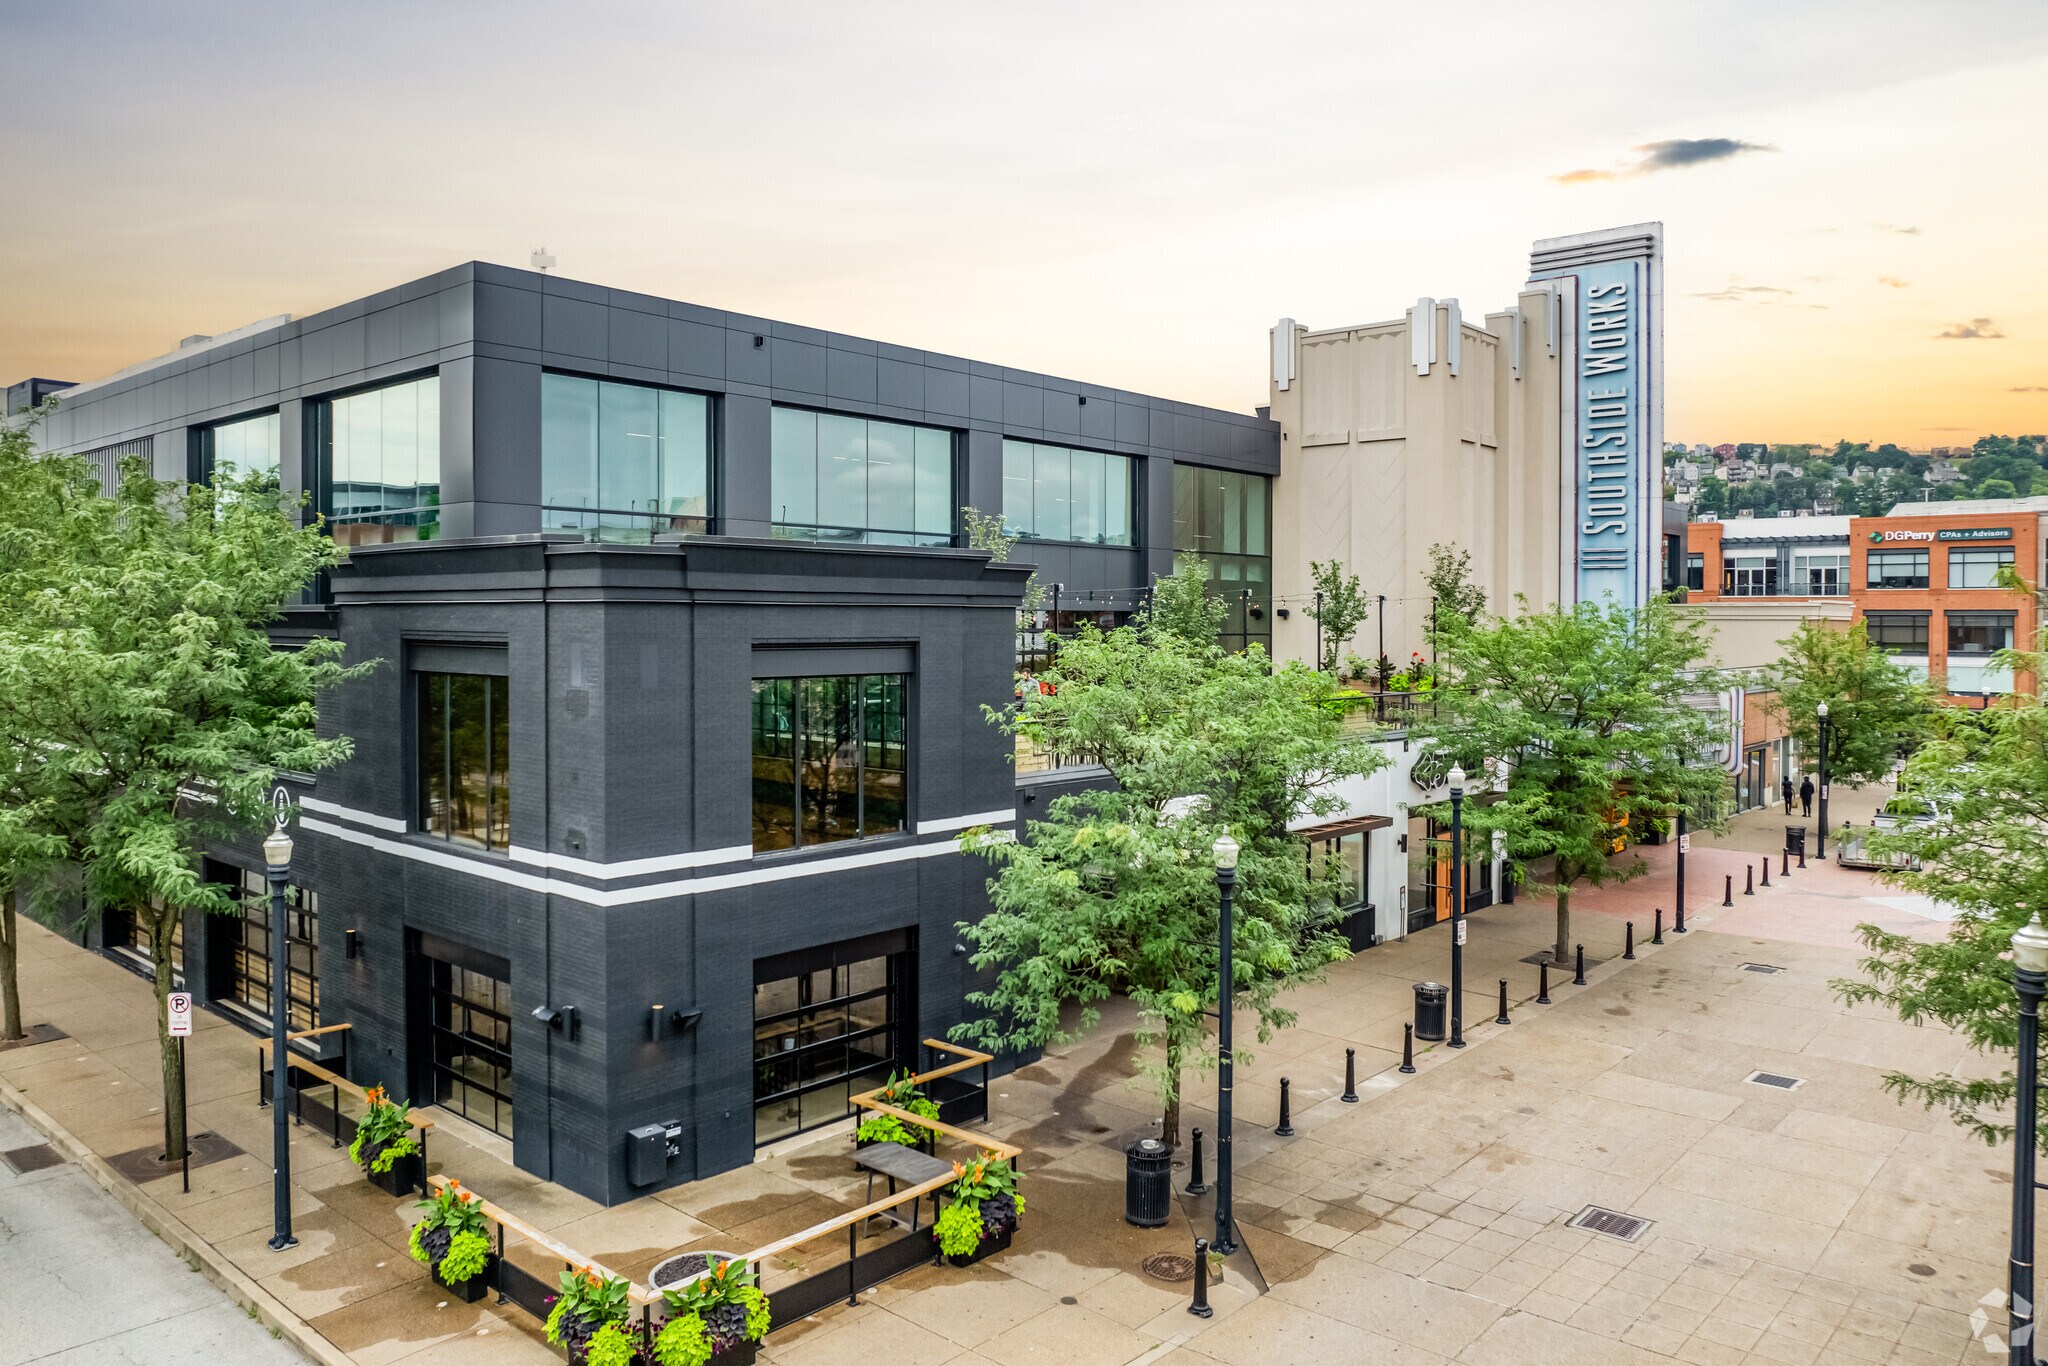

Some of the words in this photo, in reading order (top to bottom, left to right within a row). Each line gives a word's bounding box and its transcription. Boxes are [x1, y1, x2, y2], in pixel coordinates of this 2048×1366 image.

[1583, 282, 1627, 377] WORKS
[1582, 387, 1627, 535] SOUTHSIDE
[1885, 530, 1935, 543] DGPerry
